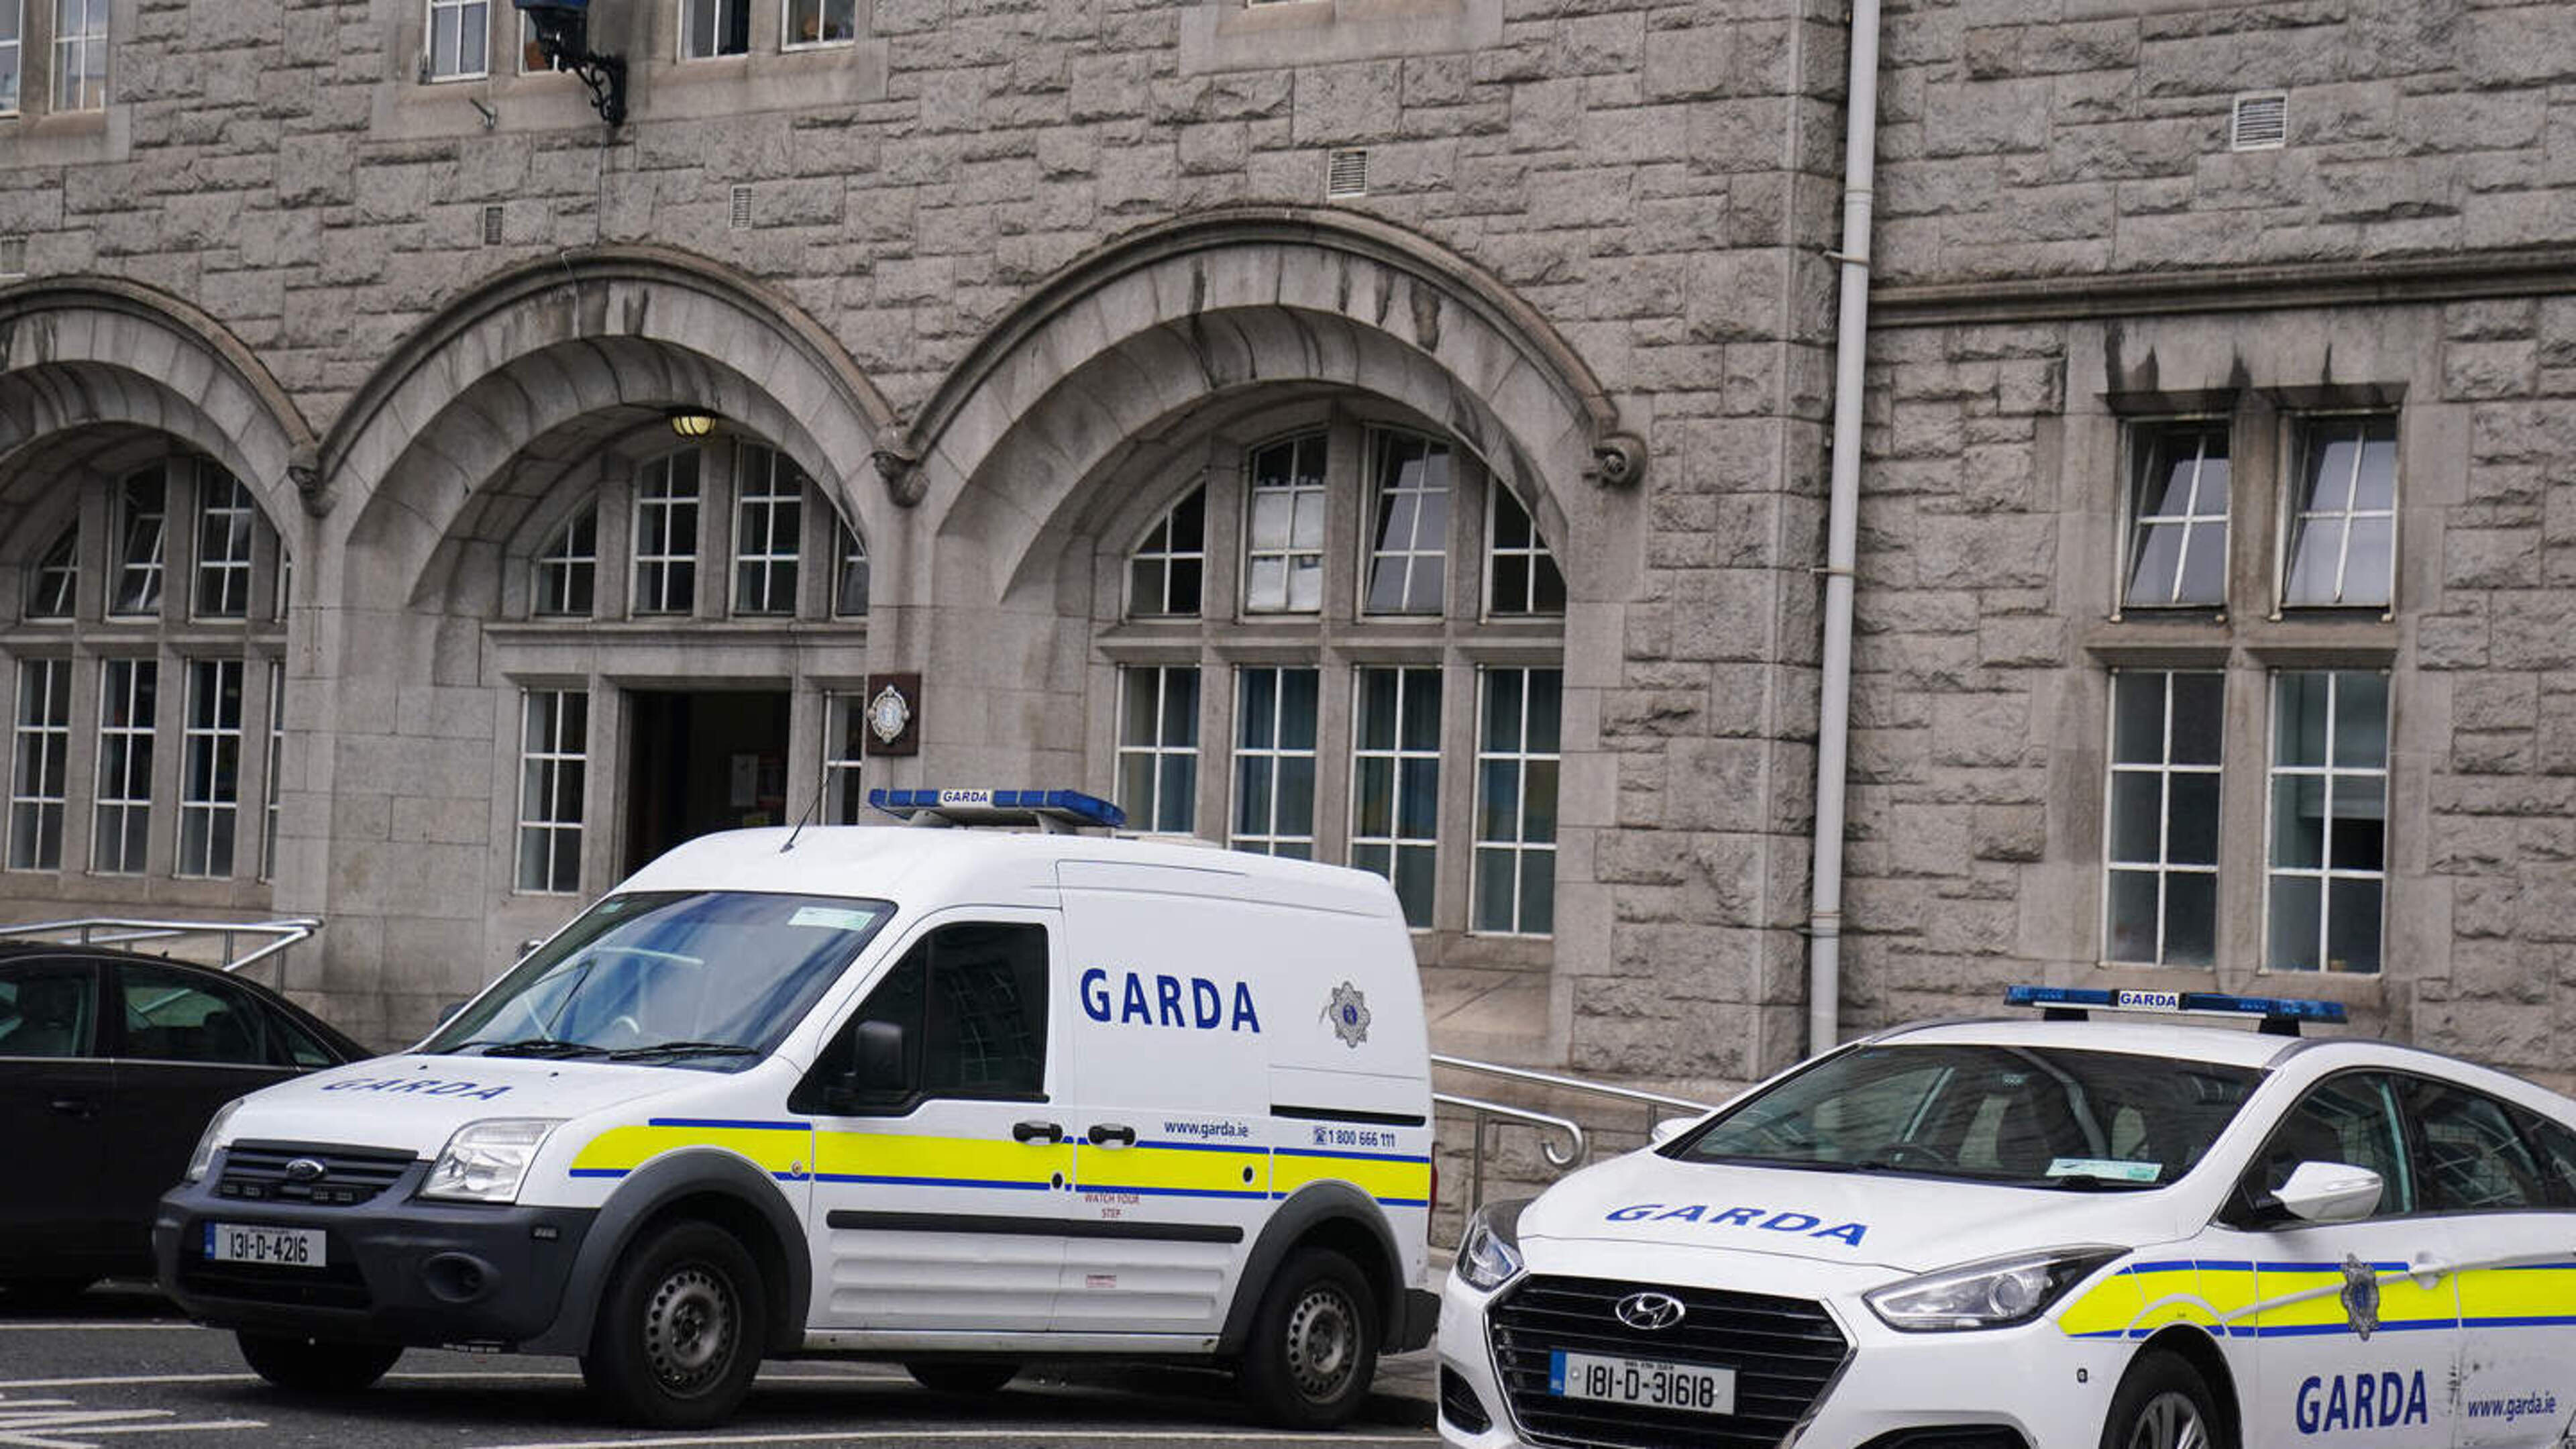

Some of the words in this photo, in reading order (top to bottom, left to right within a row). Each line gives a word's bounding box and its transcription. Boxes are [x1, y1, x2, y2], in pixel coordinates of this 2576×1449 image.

[943, 790, 988, 802] GARDA
[1080, 968, 1260, 1033] GARDA
[2119, 992, 2177, 1008] GARDA
[321, 1077, 514, 1100] GARDA
[1164, 1121, 1249, 1138] www.garda.ie
[1328, 1129, 1334, 1144] 1
[1336, 1130, 1356, 1145] 800
[1359, 1131, 1379, 1146] 666
[1381, 1132, 1395, 1148] 111
[1085, 1193, 1114, 1203] WATCH
[1116, 1194, 1140, 1205] YOUR
[1101, 1208, 1122, 1218] STEP
[1606, 1203, 1871, 1247] GARDA
[230, 1232, 309, 1263] 131-D-4216
[1585, 1364, 1715, 1408] 181-D-31618
[2296, 1369, 2428, 1435] GARDA
[2467, 1391, 2557, 1422] www.garda.ie
